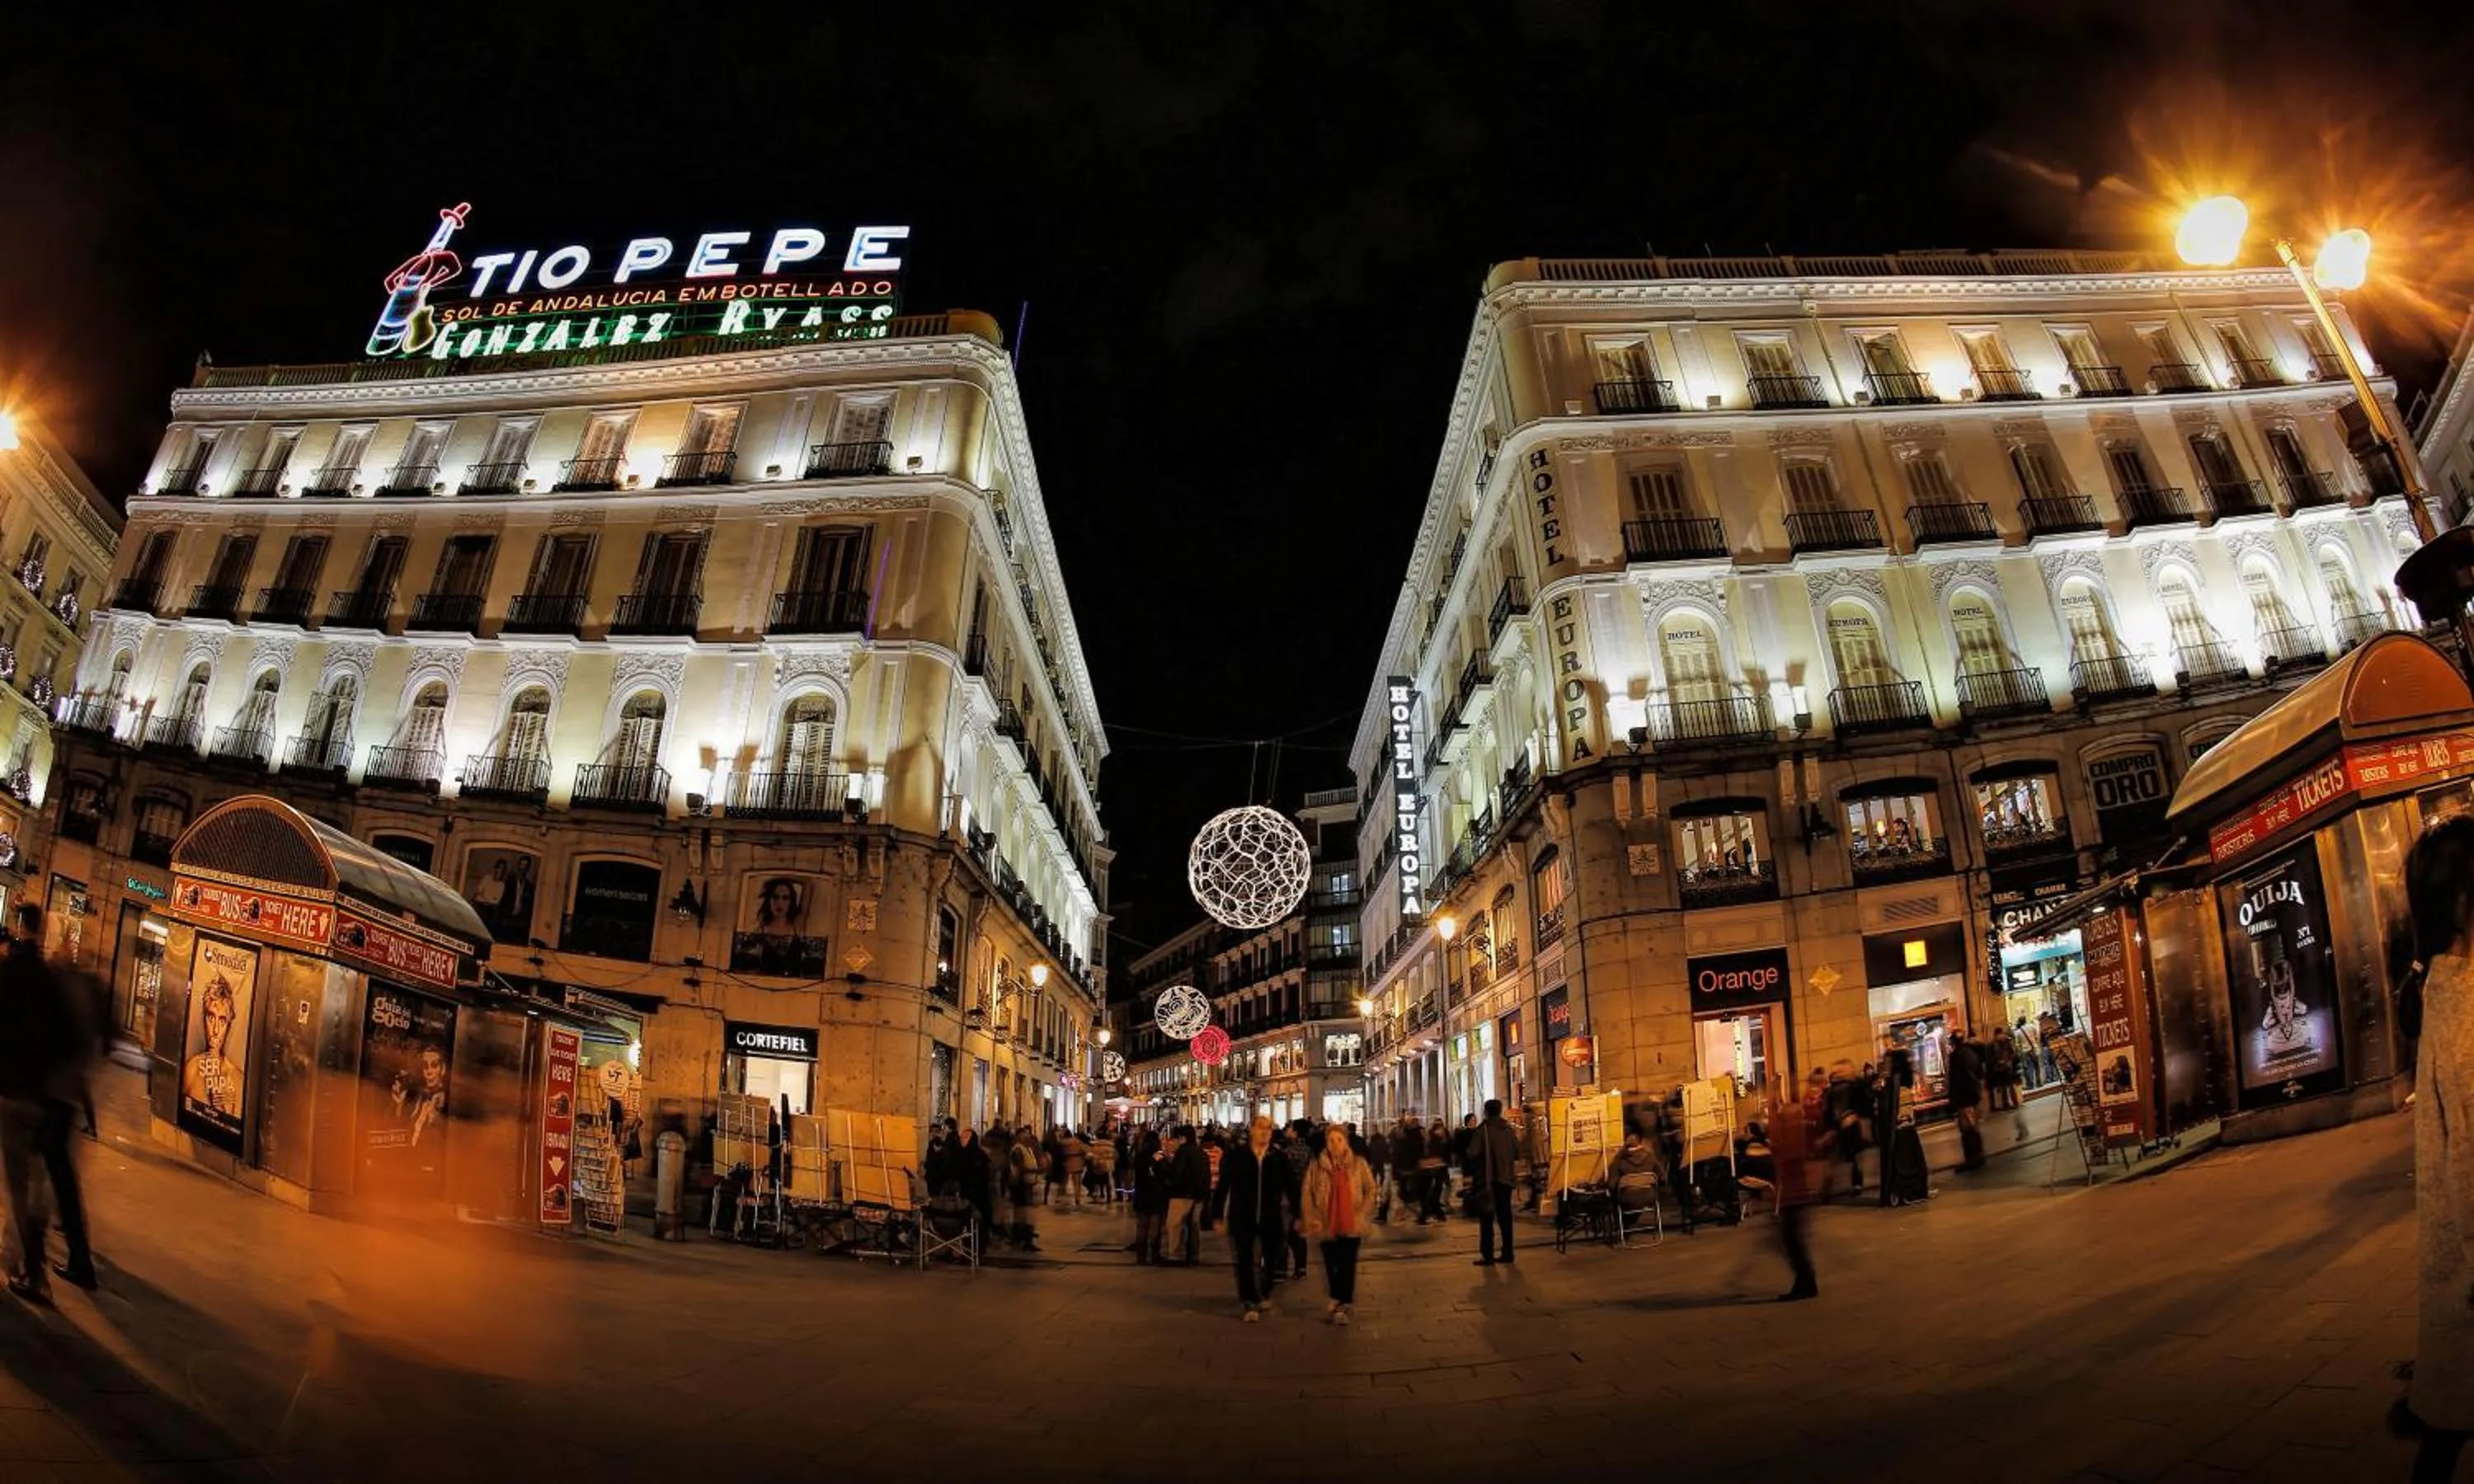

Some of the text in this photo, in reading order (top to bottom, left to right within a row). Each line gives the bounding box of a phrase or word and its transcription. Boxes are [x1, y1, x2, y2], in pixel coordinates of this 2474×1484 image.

[469, 225, 910, 298] TIO PEPE
[441, 281, 892, 322] SOL DE ANDALUCIA EMBOTELLADO
[1530, 448, 1564, 567] HOTEL
[1828, 618, 1870, 628] EUROPA
[1953, 607, 1983, 617] HOTEL
[1667, 630, 1703, 641] HOTEL
[1551, 596, 1594, 763] EUROPA
[1390, 685, 1413, 779] HOTEL
[2089, 753, 2154, 777] COMPRO
[2293, 758, 2345, 812] TICKETS
[2093, 768, 2161, 807] ORO
[1398, 793, 1421, 914] EUROPA
[219, 892, 242, 920] BUS
[280, 904, 319, 938] HERE
[2239, 881, 2305, 926] OUIJA
[388, 936, 409, 967] BUS
[421, 950, 449, 981] HERE
[1699, 967, 1779, 992] Orange
[736, 1031, 807, 1052] CORTEFIEL
[2096, 1017, 2131, 1049] TICKETS
[552, 1063, 573, 1083] HERE
